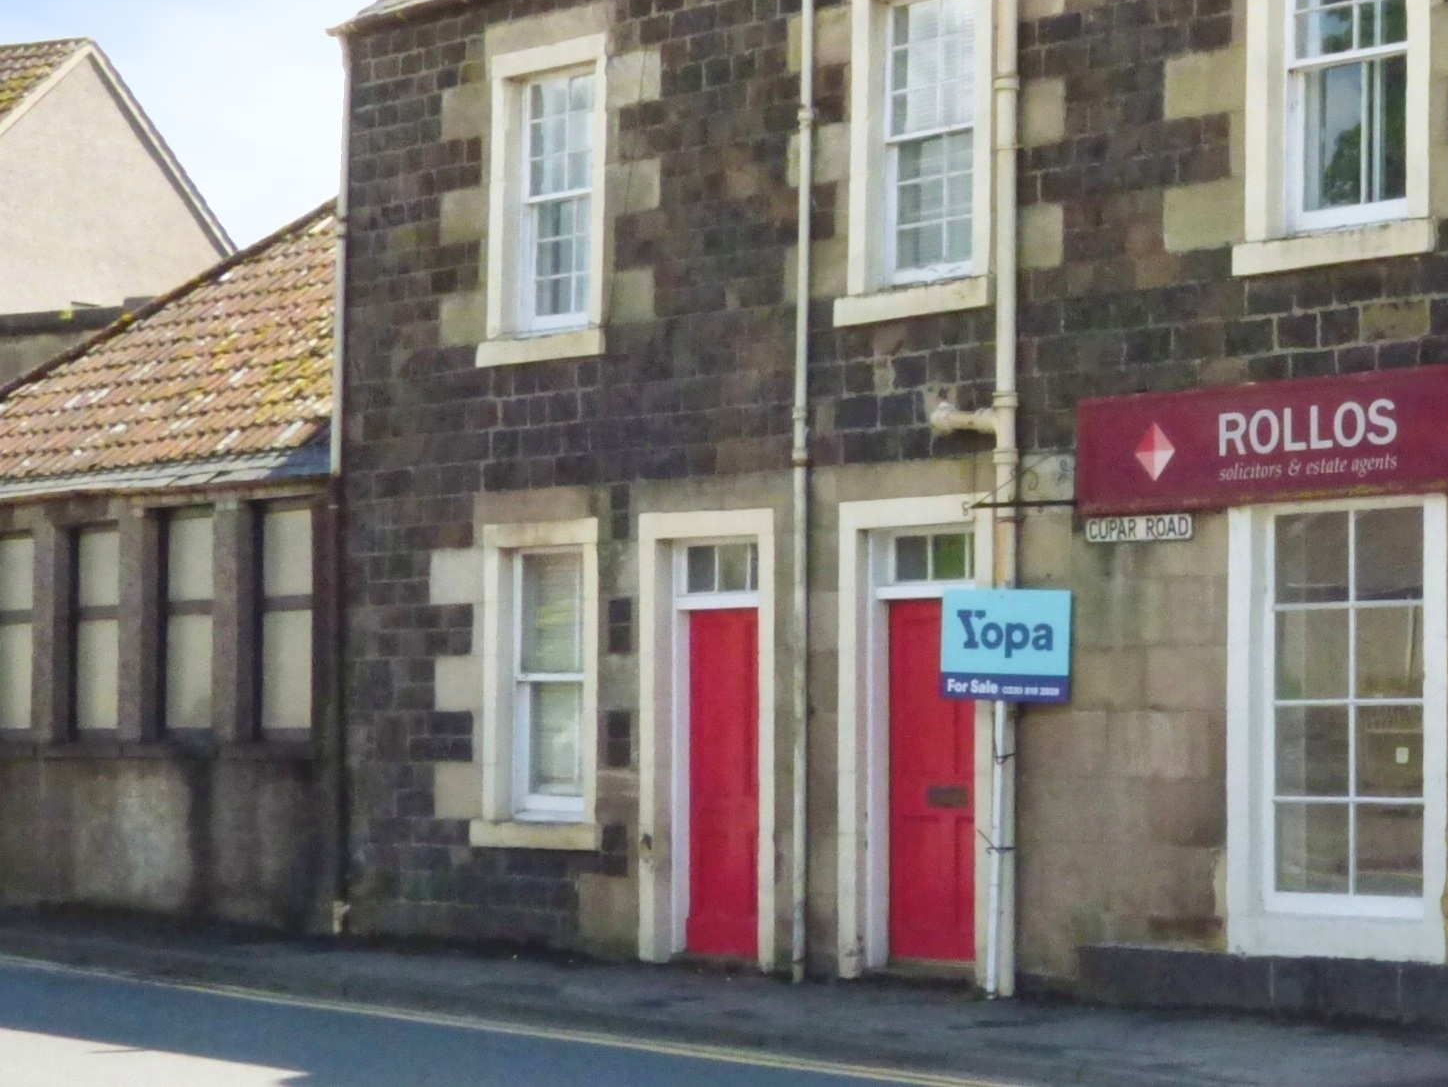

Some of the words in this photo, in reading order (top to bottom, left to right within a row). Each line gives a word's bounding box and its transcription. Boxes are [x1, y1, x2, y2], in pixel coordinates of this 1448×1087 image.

[1218, 398, 1398, 457] ROLLOS
[1218, 462, 1282, 482] solicitors
[1288, 458, 1300, 476] &
[1306, 456, 1348, 475] estate
[1351, 453, 1398, 479] agents
[1089, 519, 1137, 539] CUPAR
[1146, 517, 1189, 537] ROAD
[957, 609, 1054, 658] Yopa
[947, 679, 968, 692] For
[970, 680, 998, 694] Sale
